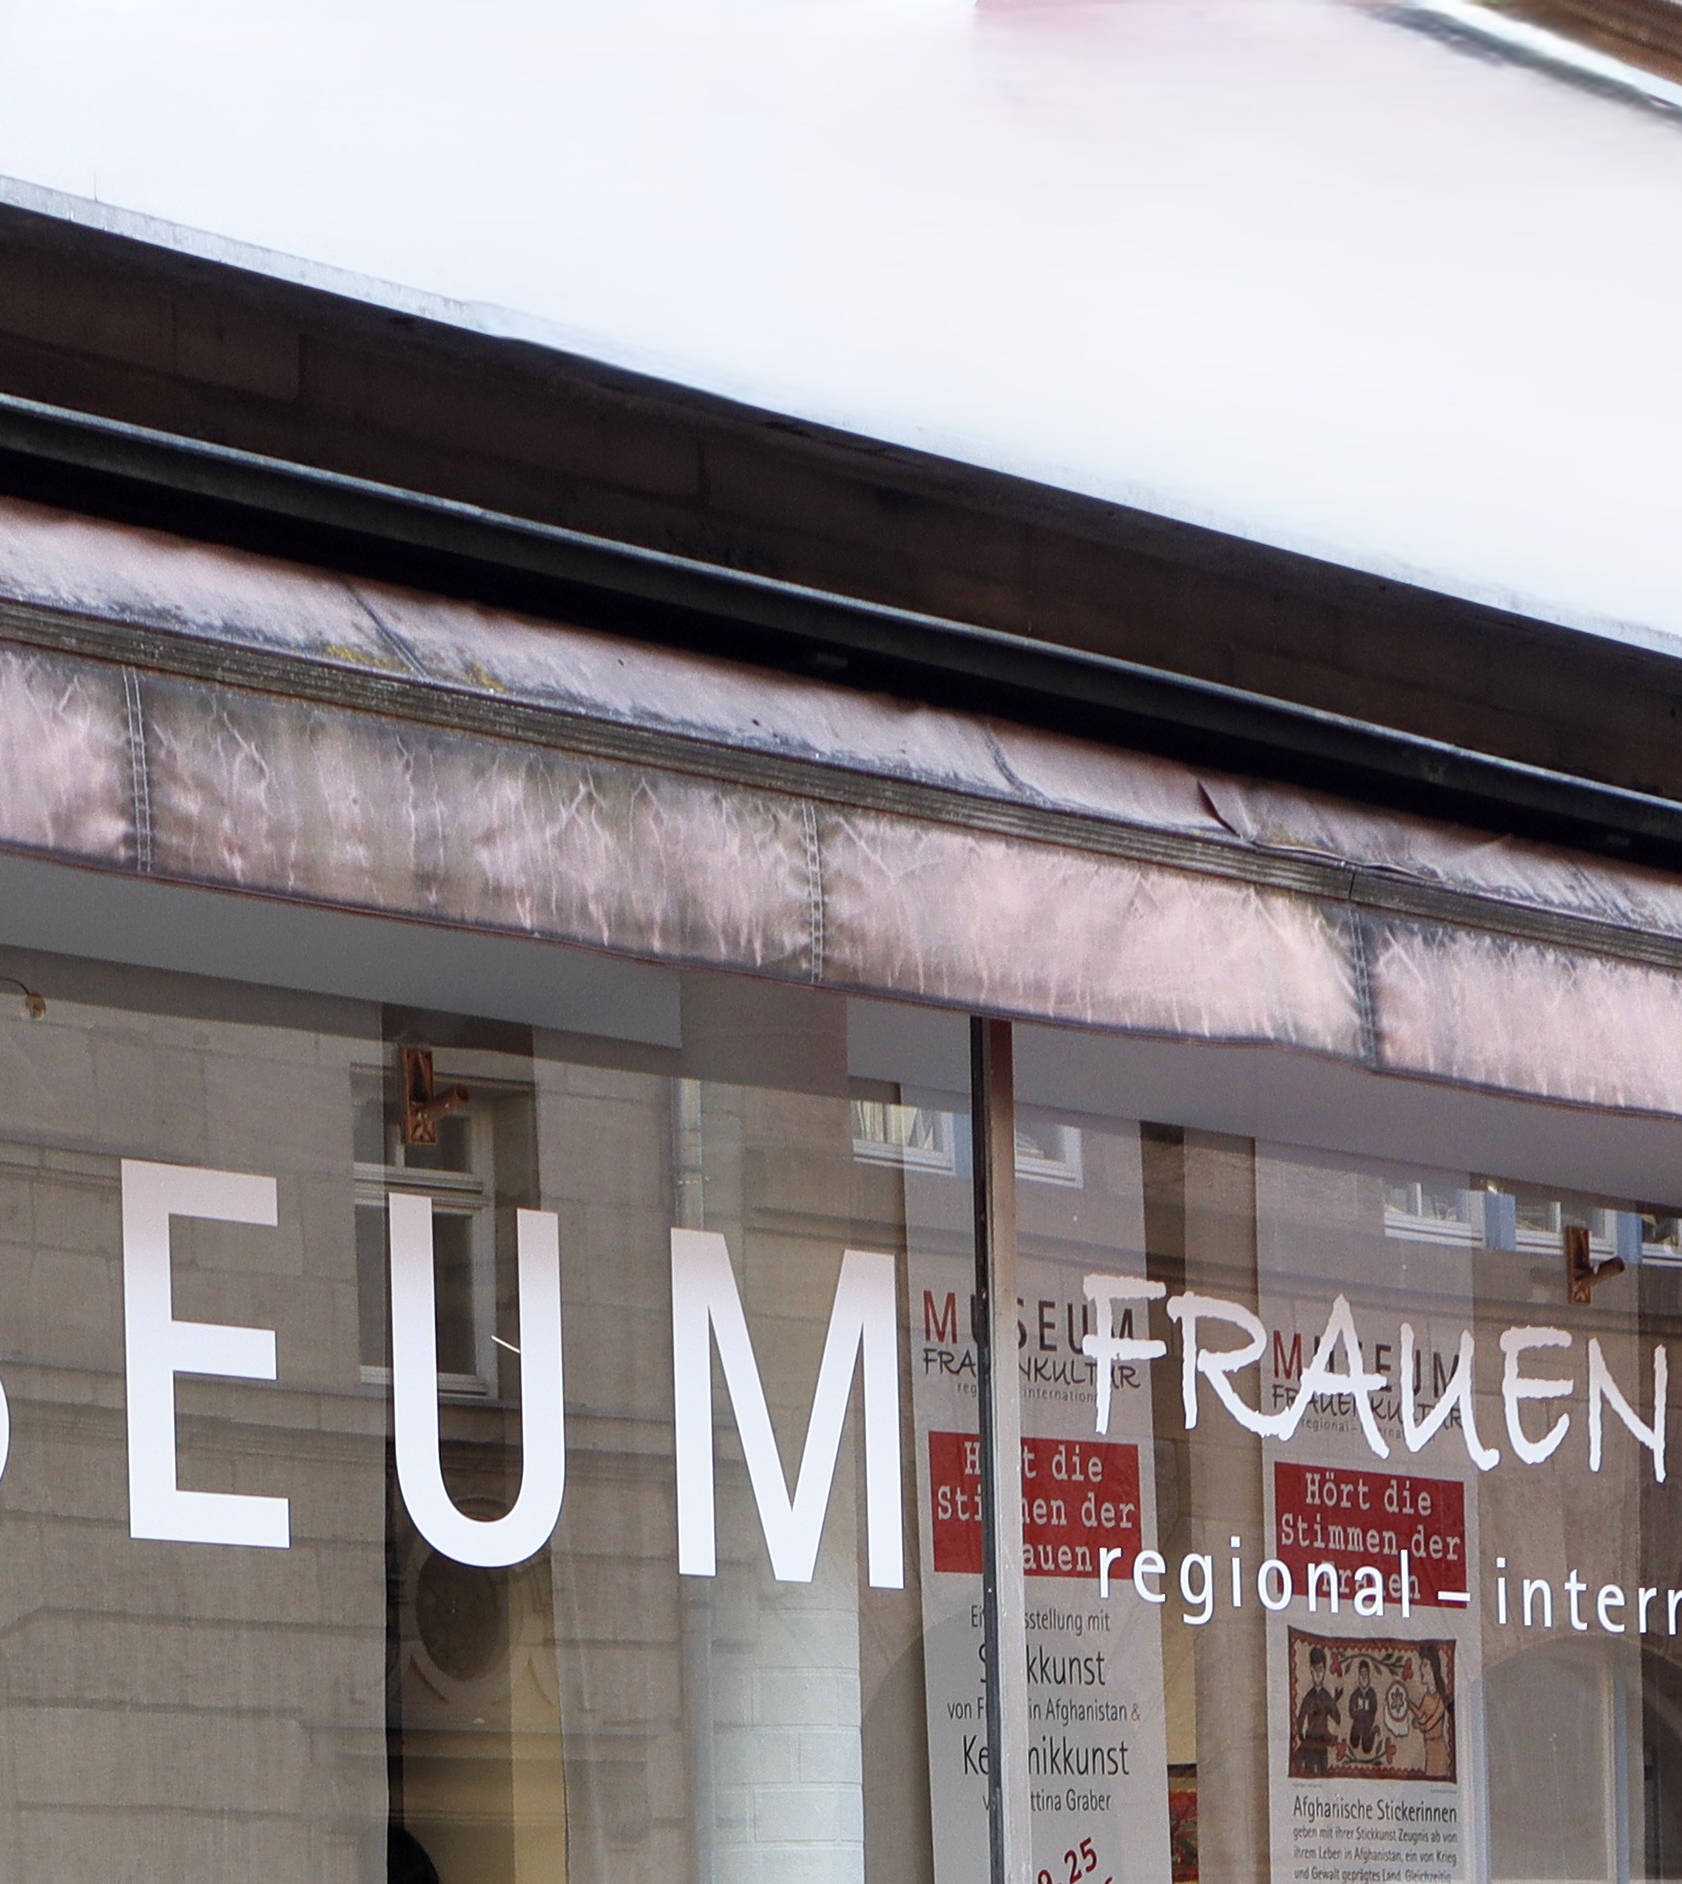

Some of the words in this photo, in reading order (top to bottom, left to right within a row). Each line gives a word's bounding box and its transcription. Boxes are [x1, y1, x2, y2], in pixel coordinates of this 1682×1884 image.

[1052, 1445, 1102, 1482] die
[938, 1486, 1067, 1526] Stien
[1082, 1493, 1135, 1528] der
[1306, 1472, 1370, 1510] Hört
[1384, 1480, 1431, 1517] die
[1282, 1513, 1398, 1553] Stimmen
[1412, 1526, 1460, 1560] der
[1097, 1536, 1411, 1626] regional
[1088, 1611, 1110, 1632] mit
[948, 1702, 972, 1720] von
[1029, 1702, 1041, 1720] in
[1046, 1698, 1127, 1727] Afghanistan
[1131, 1704, 1141, 1721] &
[1066, 1789, 1110, 1811] Graber
[1293, 1795, 1372, 1823] Afghanische
[1377, 1800, 1457, 1823] Stickerinnen
